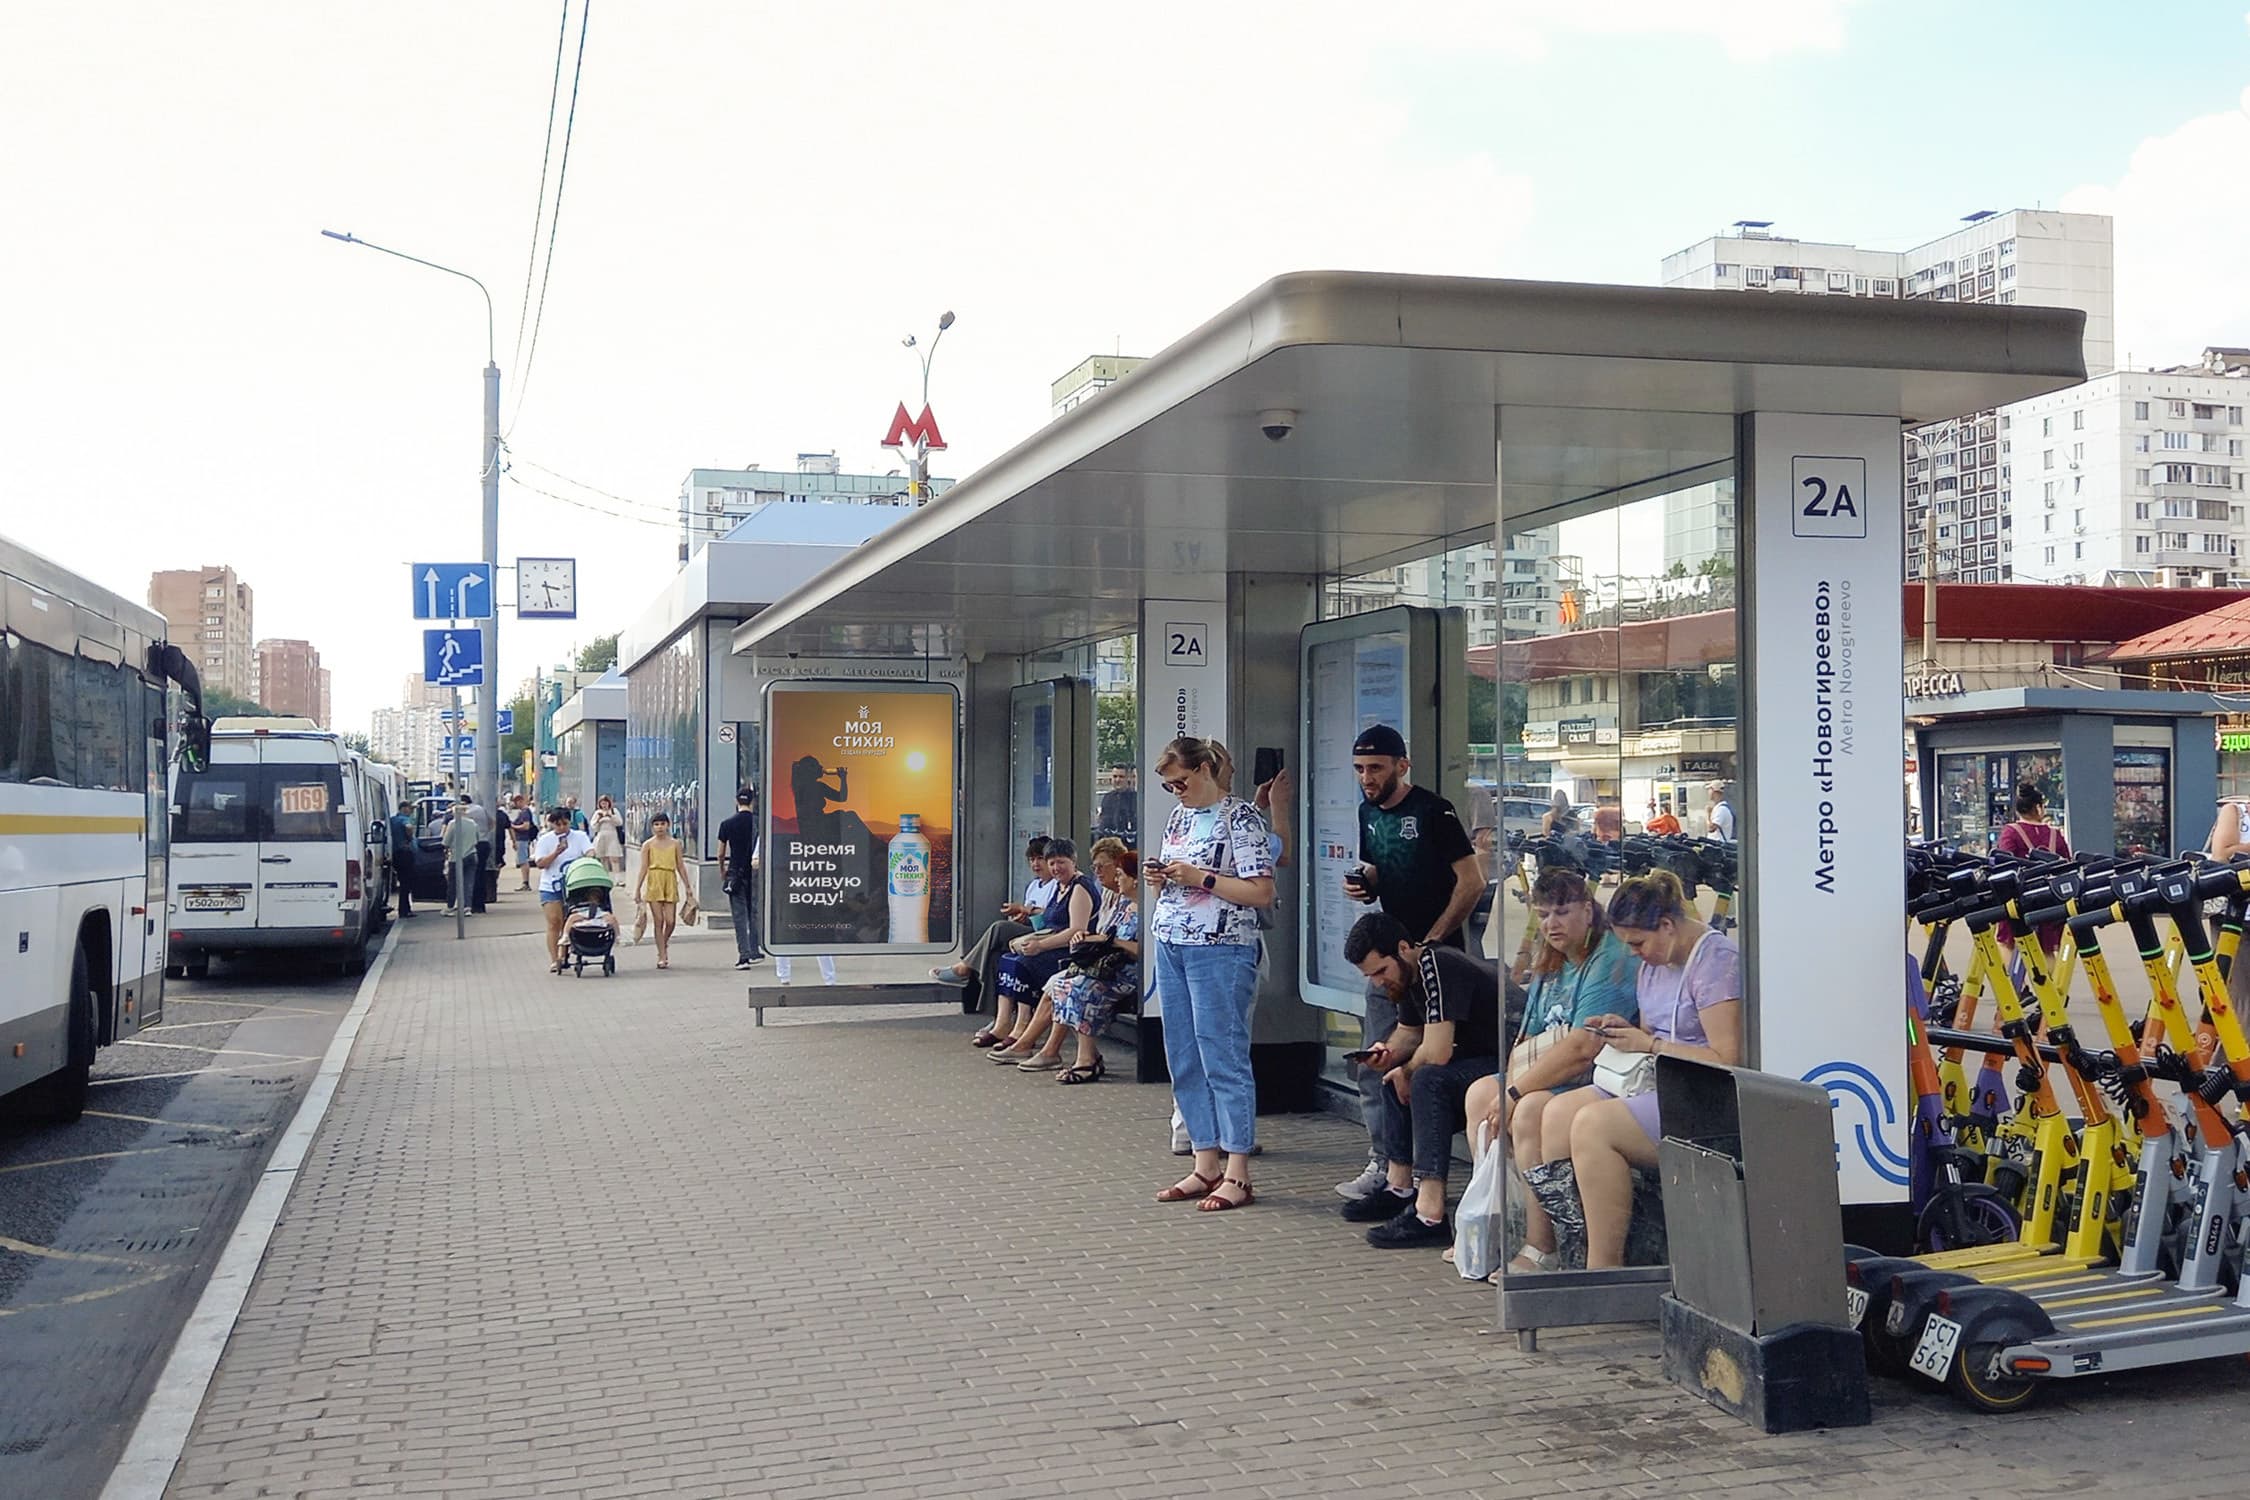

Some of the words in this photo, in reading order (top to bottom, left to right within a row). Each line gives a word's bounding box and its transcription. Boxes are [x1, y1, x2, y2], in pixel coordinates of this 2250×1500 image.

[881, 400, 947, 448] М
[1803, 477, 1857, 517] 2А
[1171, 634, 1202, 655] 2А
[1838, 580, 1854, 693] Novogireevo
[1813, 581, 1835, 792] «Новогиреево»
[845, 721, 882, 734] МОЯ
[1840, 700, 1853, 755] Metro
[833, 736, 895, 748] СТИХИЯ
[283, 788, 323, 811] 1169
[790, 842, 855, 857] Время
[1815, 801, 1838, 894] Метро
[790, 861, 837, 871] пить
[895, 872, 925, 880] СТИХИЯ
[900, 864, 919, 872] МОЯ
[789, 876, 861, 888] живую
[789, 891, 844, 906] воду!
[1914, 1345, 1949, 1375] 567
